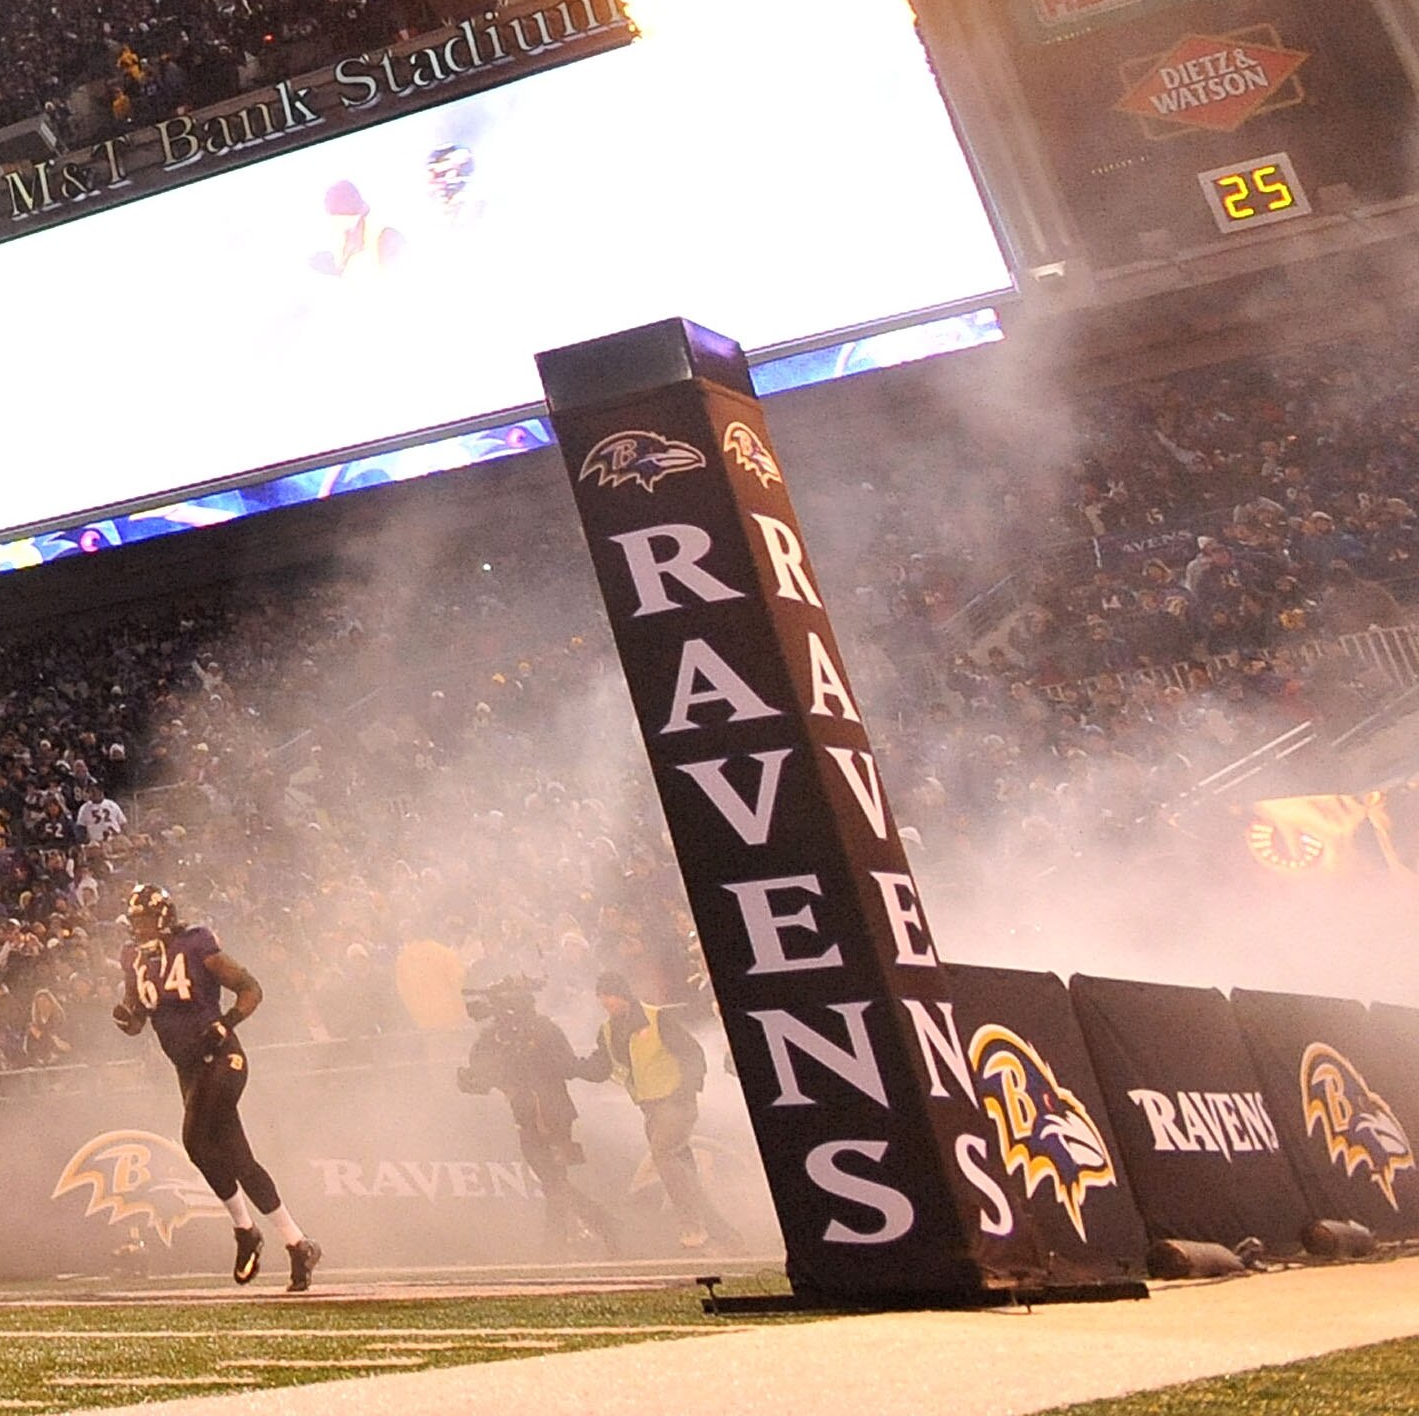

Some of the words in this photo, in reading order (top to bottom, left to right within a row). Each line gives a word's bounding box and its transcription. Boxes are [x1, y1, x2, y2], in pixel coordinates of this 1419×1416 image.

[1150, 66, 1269, 115] WATSON
[1159, 51, 1234, 90] DIETZ
[1233, 47, 1258, 68] &
[5, 136, 133, 218] M&T
[155, 81, 323, 170] Bank
[1217, 165, 1293, 220] 25
[91, 808, 112, 824] 52
[136, 952, 192, 1011] 64
